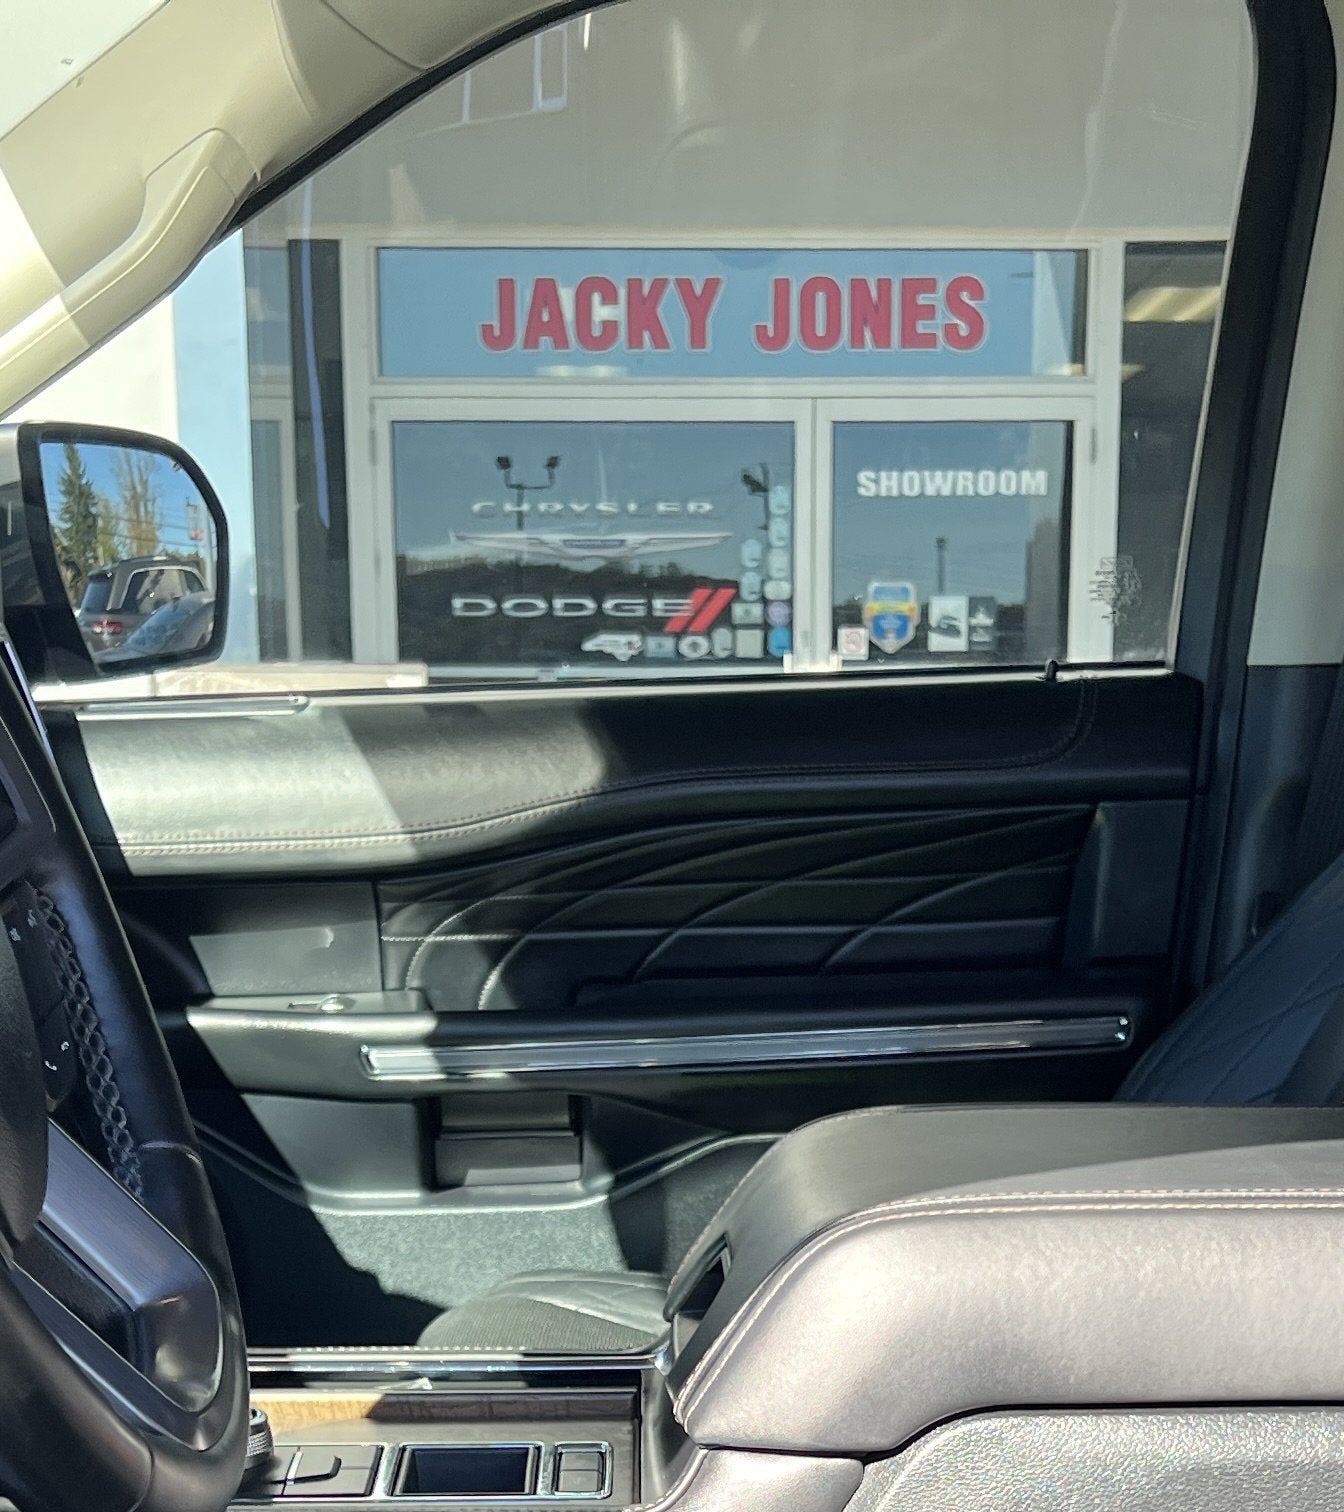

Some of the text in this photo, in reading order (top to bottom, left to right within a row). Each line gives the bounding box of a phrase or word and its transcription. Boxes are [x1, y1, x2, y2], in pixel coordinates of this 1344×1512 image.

[481, 276, 986, 351] JACKY JONES
[856, 469, 1049, 497] SHOWROOM
[451, 598, 695, 618] DODGE
